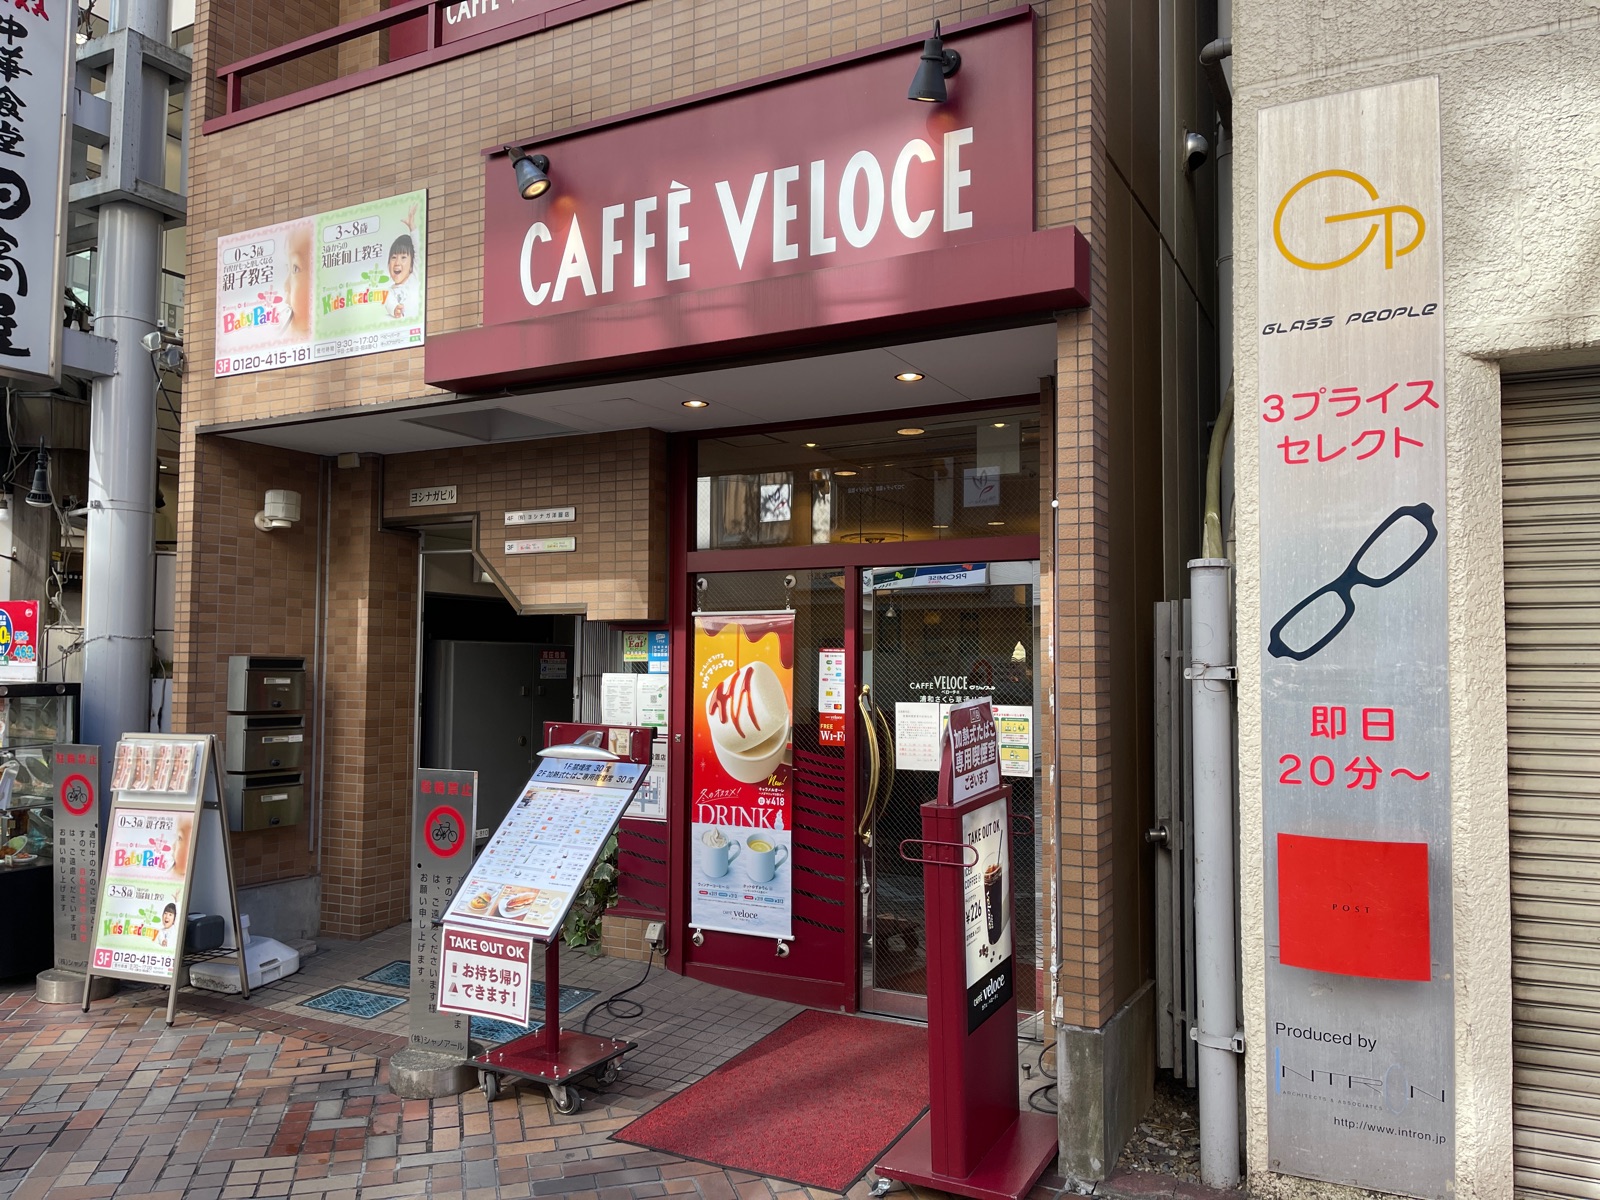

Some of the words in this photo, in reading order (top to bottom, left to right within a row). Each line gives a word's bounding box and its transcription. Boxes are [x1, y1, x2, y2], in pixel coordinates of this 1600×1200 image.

[519, 180, 692, 306] CAFFÈ
[715, 127, 974, 270] VELOCE
[322, 243, 383, 269] 知能向上教室
[223, 265, 274, 292] 親子教室
[1262, 315, 1336, 336] GLASS
[1346, 303, 1438, 326] PEOPLE
[217, 361, 229, 374] 3F
[232, 347, 311, 372] 0120-415-181
[1262, 380, 1440, 423] 3プライス
[1277, 426, 1424, 465] セレクト
[411, 489, 455, 503] ヨシナガビル
[628, 640, 644, 648] Eat
[933, 675, 968, 690] VELOCE
[954, 720, 996, 749] 加熱式たばこ
[1310, 706, 1395, 742] 即日
[594, 764, 605, 772] 30
[955, 740, 996, 774] 専用喫煙室
[616, 775, 627, 784] 30
[965, 769, 989, 791] ございます
[697, 804, 775, 830] DRINK
[967, 828, 981, 846] TAKE
[981, 822, 992, 839] OUT
[992, 818, 1000, 834] OK
[733, 910, 759, 919] veloce
[965, 900, 982, 924] ¥226
[1332, 903, 1372, 914] POST
[417, 873, 429, 984] お願い申し上げます。
[97, 951, 111, 965] 3F
[449, 936, 477, 951] TAKE
[480, 940, 504, 956] OUT
[506, 945, 524, 959] OK
[462, 963, 522, 987] お持ち帰り
[982, 974, 1006, 1000] veloce
[462, 983, 516, 1007] できます!
[1275, 1022, 1352, 1046] Produced
[1358, 1034, 1377, 1052] by
[1275, 1046, 1446, 1115] INTRON
[1283, 1090, 1327, 1102] ARCHITECTS
[1338, 1099, 1383, 1111] ASSOCIATES
[1334, 1116, 1447, 1145] http://www.intron.jp
